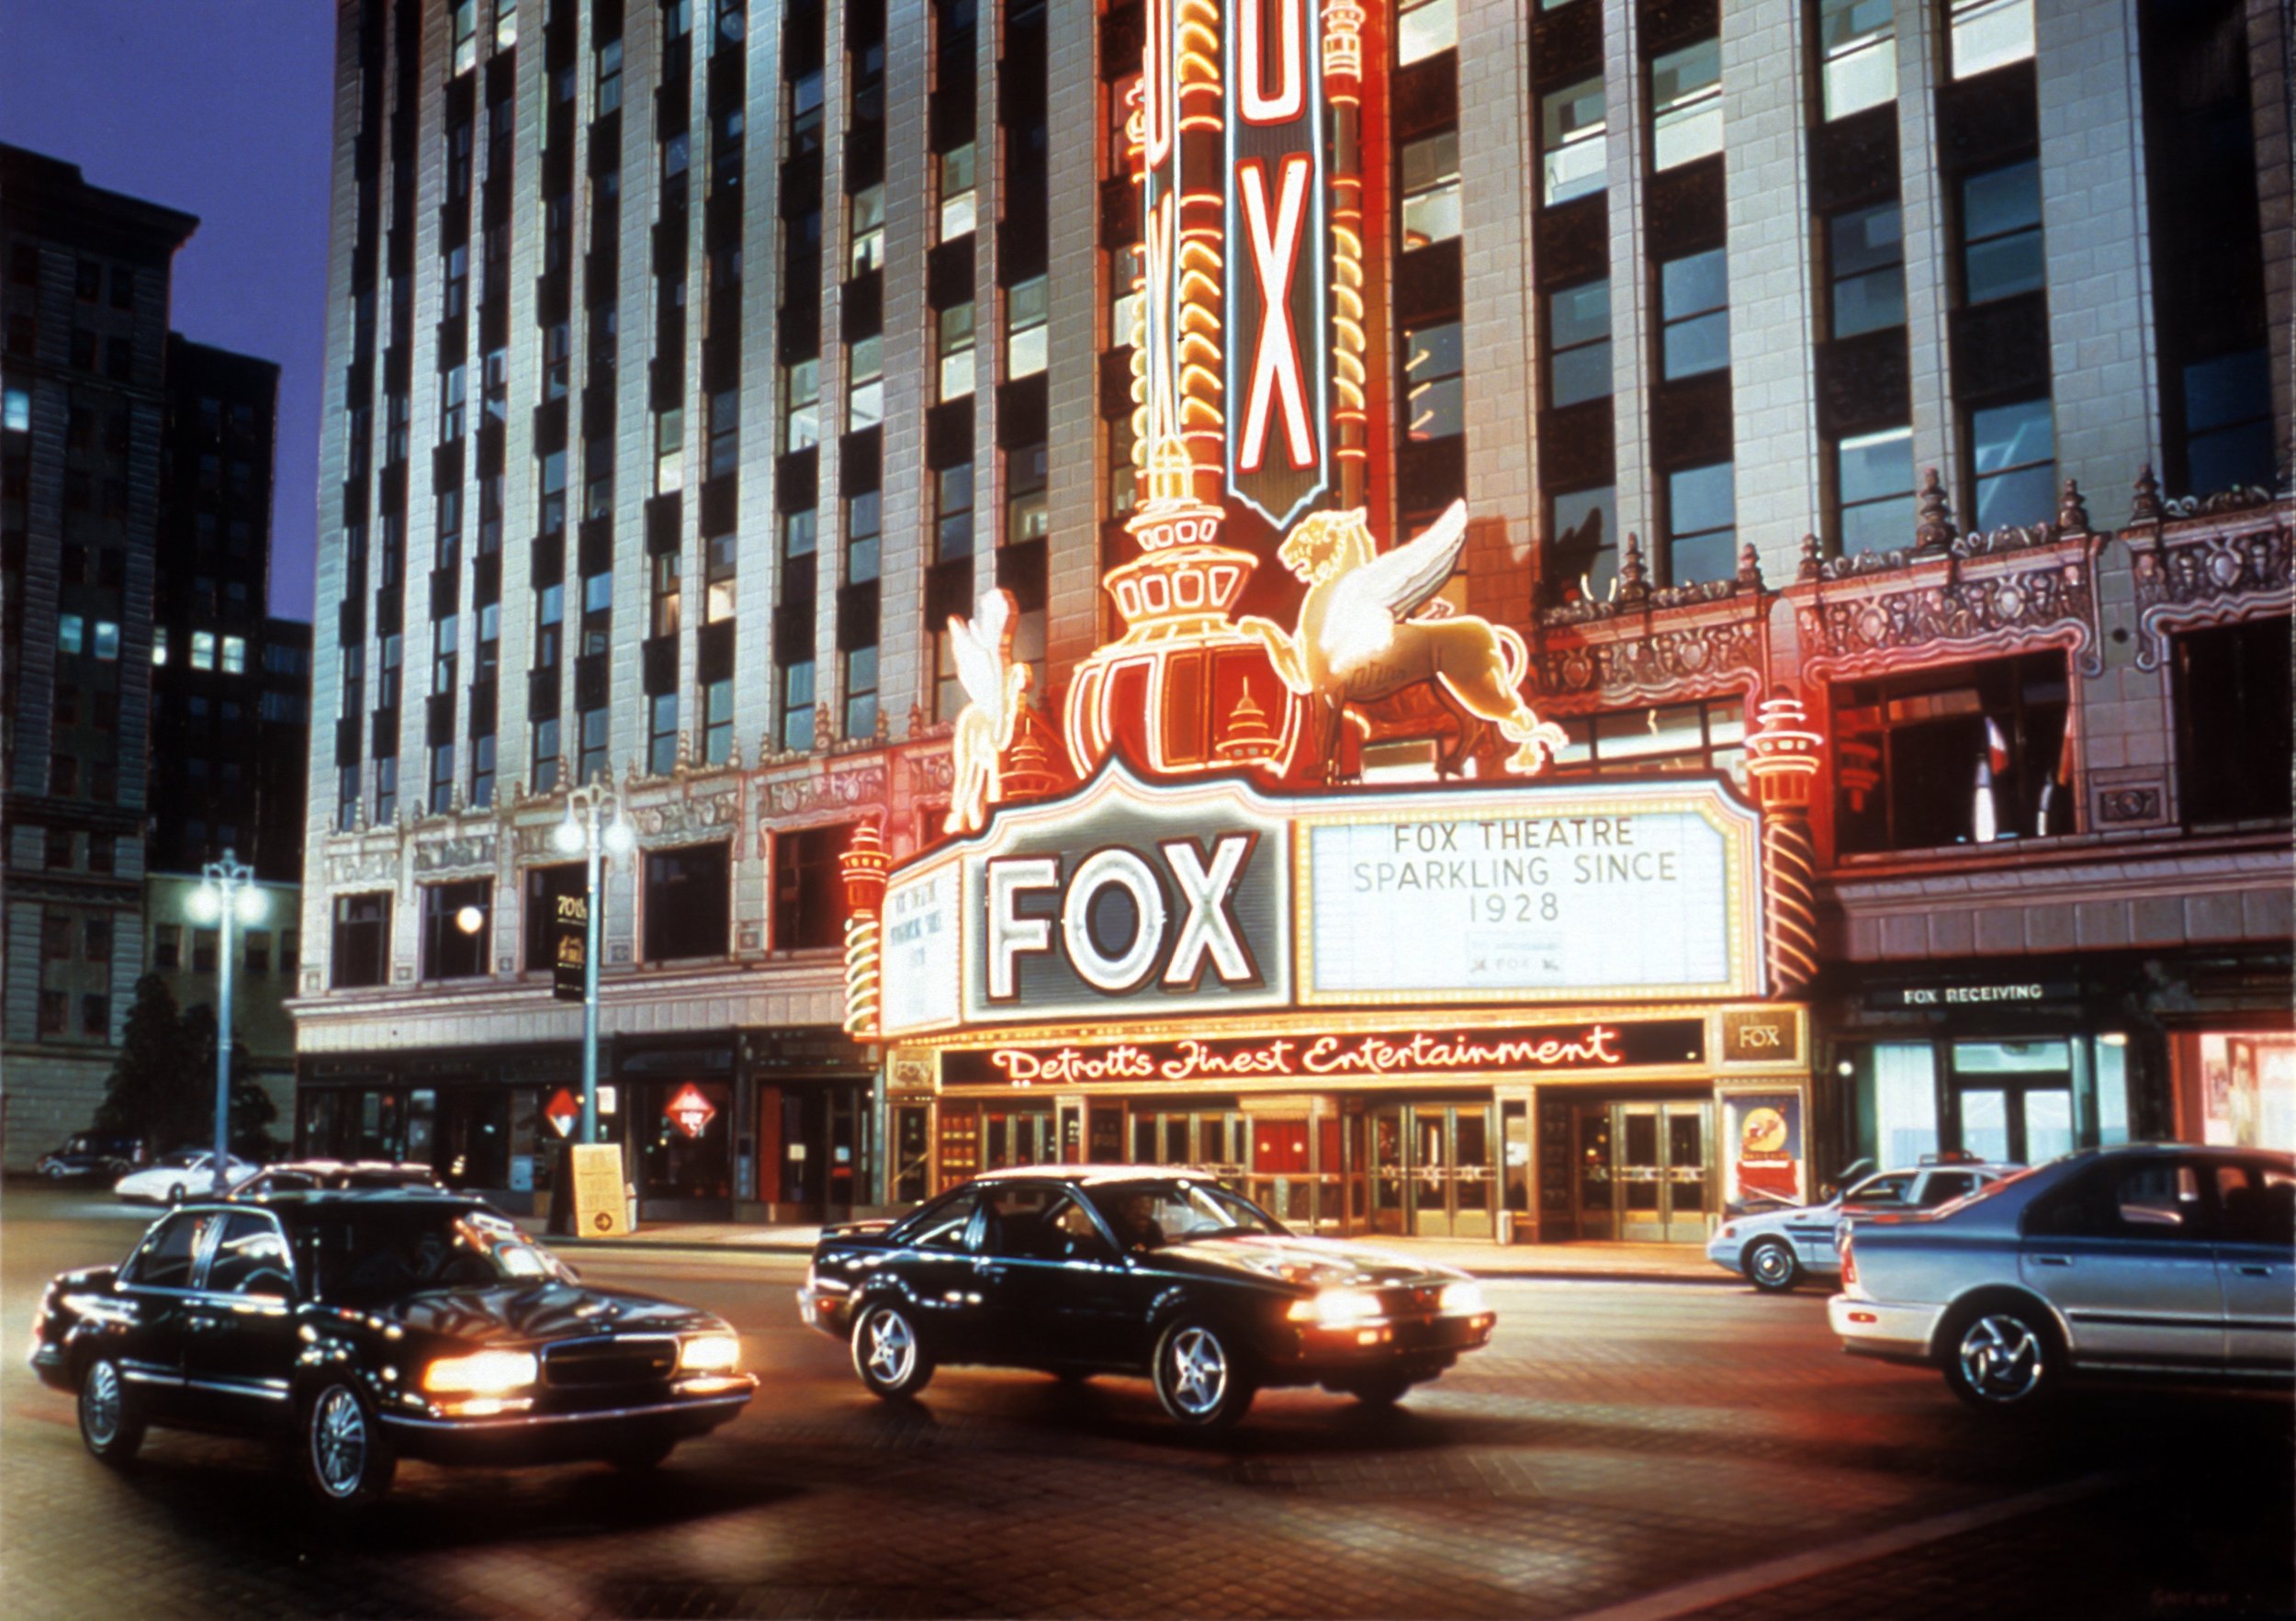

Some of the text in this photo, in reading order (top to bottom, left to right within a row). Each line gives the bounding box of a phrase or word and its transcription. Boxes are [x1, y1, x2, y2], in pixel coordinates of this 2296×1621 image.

[1395, 816, 1634, 852] FOX THEATRE
[1353, 852, 1677, 892] SPARKLING SINCE
[985, 830, 1265, 1003] FOX
[1469, 893, 1559, 922] 1928
[1904, 984, 2043, 1004] FOX RECEIVING
[1162, 1040, 1294, 1079] Finest
[1303, 1026, 1620, 1073] Entertainment
[1739, 1026, 1780, 1048] FOX
